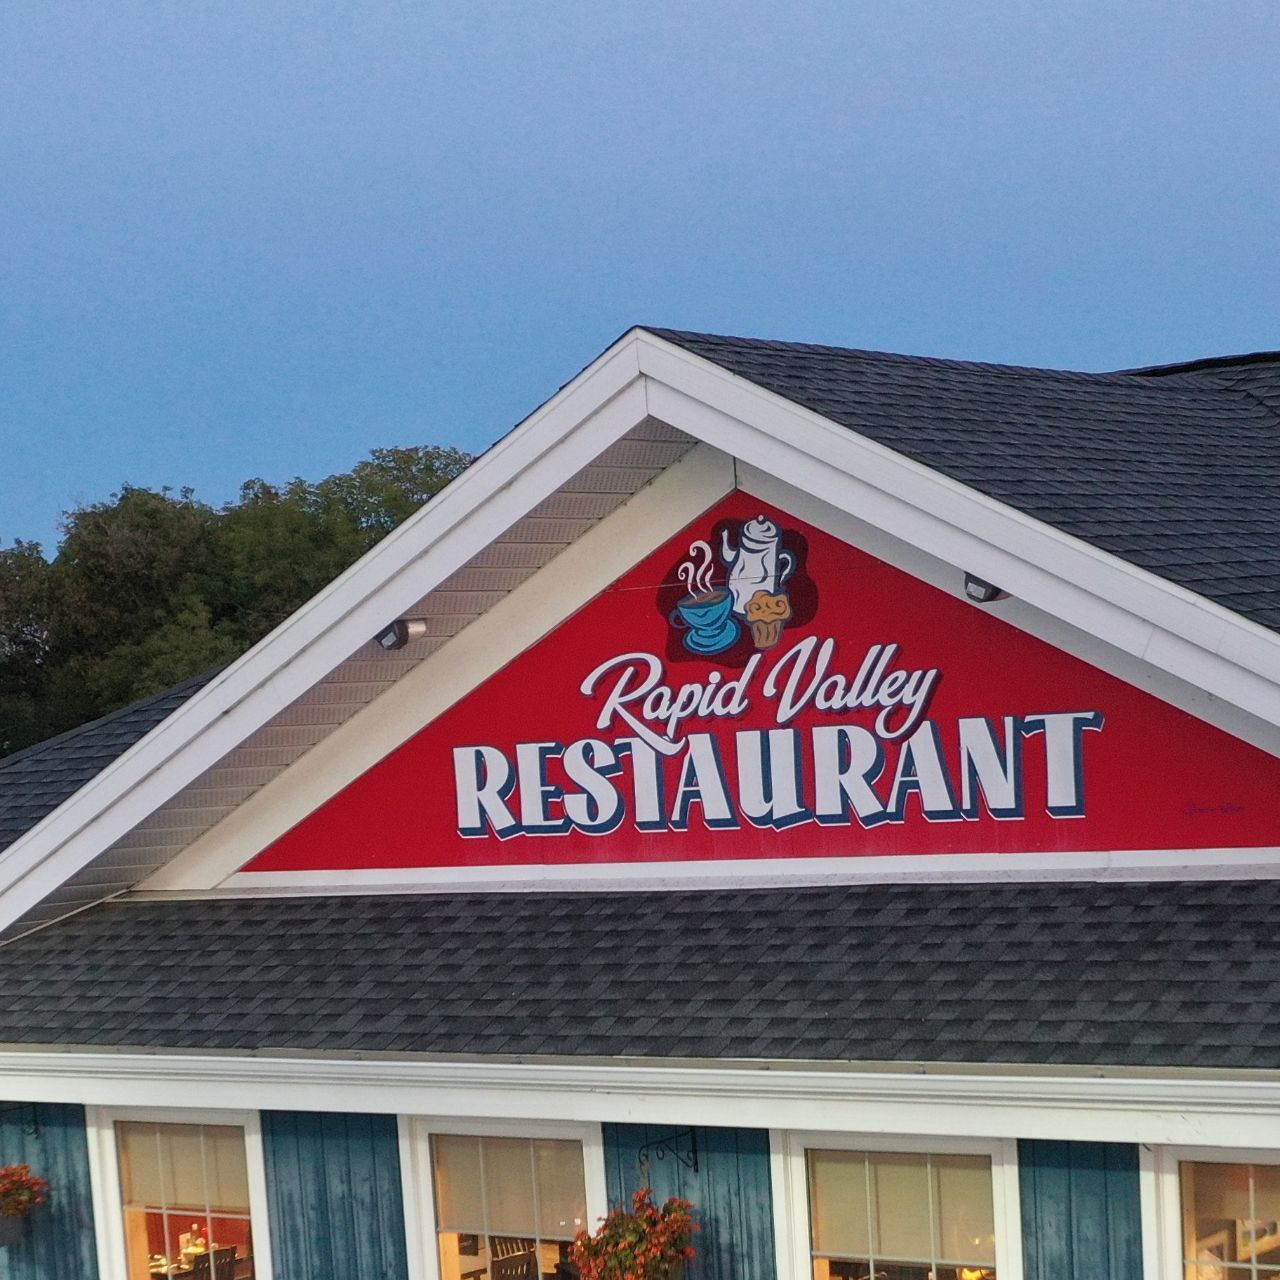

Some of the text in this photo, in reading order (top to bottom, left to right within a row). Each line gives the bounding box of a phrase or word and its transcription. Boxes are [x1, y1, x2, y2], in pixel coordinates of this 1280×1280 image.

[580, 636, 939, 756] Rapid Valley
[452, 711, 1105, 840] RESTAURANT
